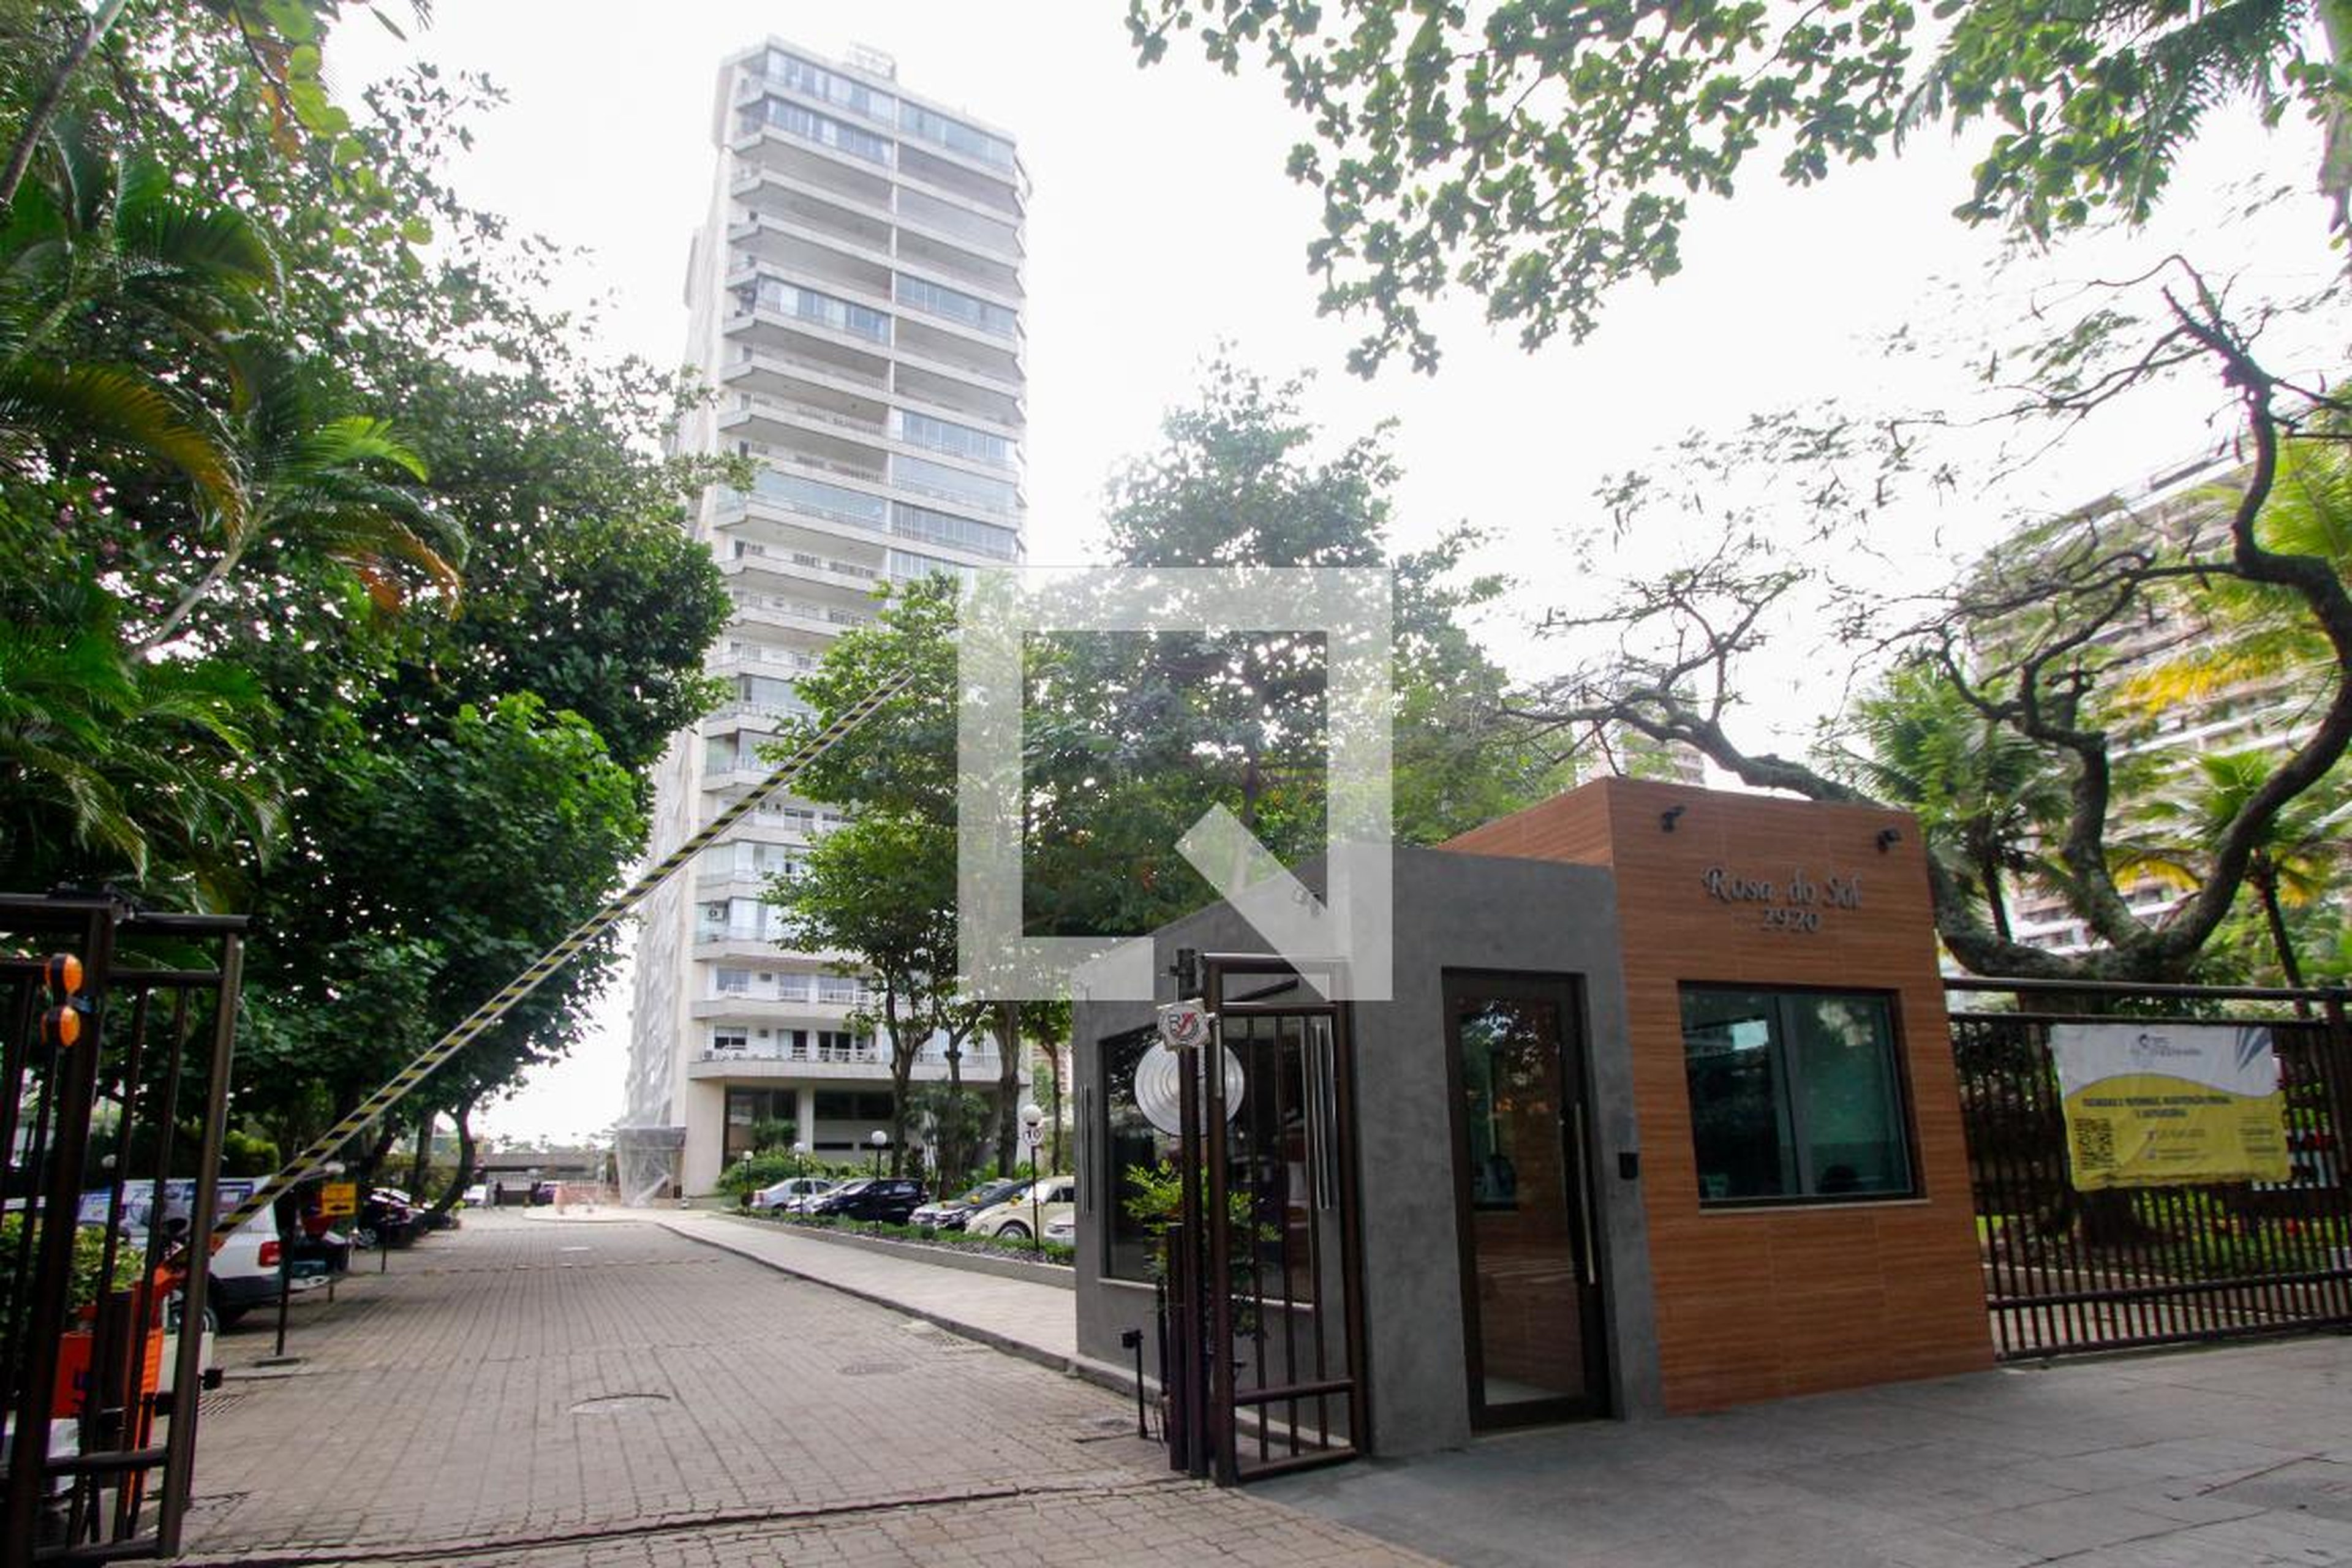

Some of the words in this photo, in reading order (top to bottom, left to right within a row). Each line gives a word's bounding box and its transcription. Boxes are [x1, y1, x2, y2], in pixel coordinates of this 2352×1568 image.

[1701, 866, 1776, 903] Rosa
[1787, 867, 1816, 905] do
[1822, 872, 1863, 909] Sol
